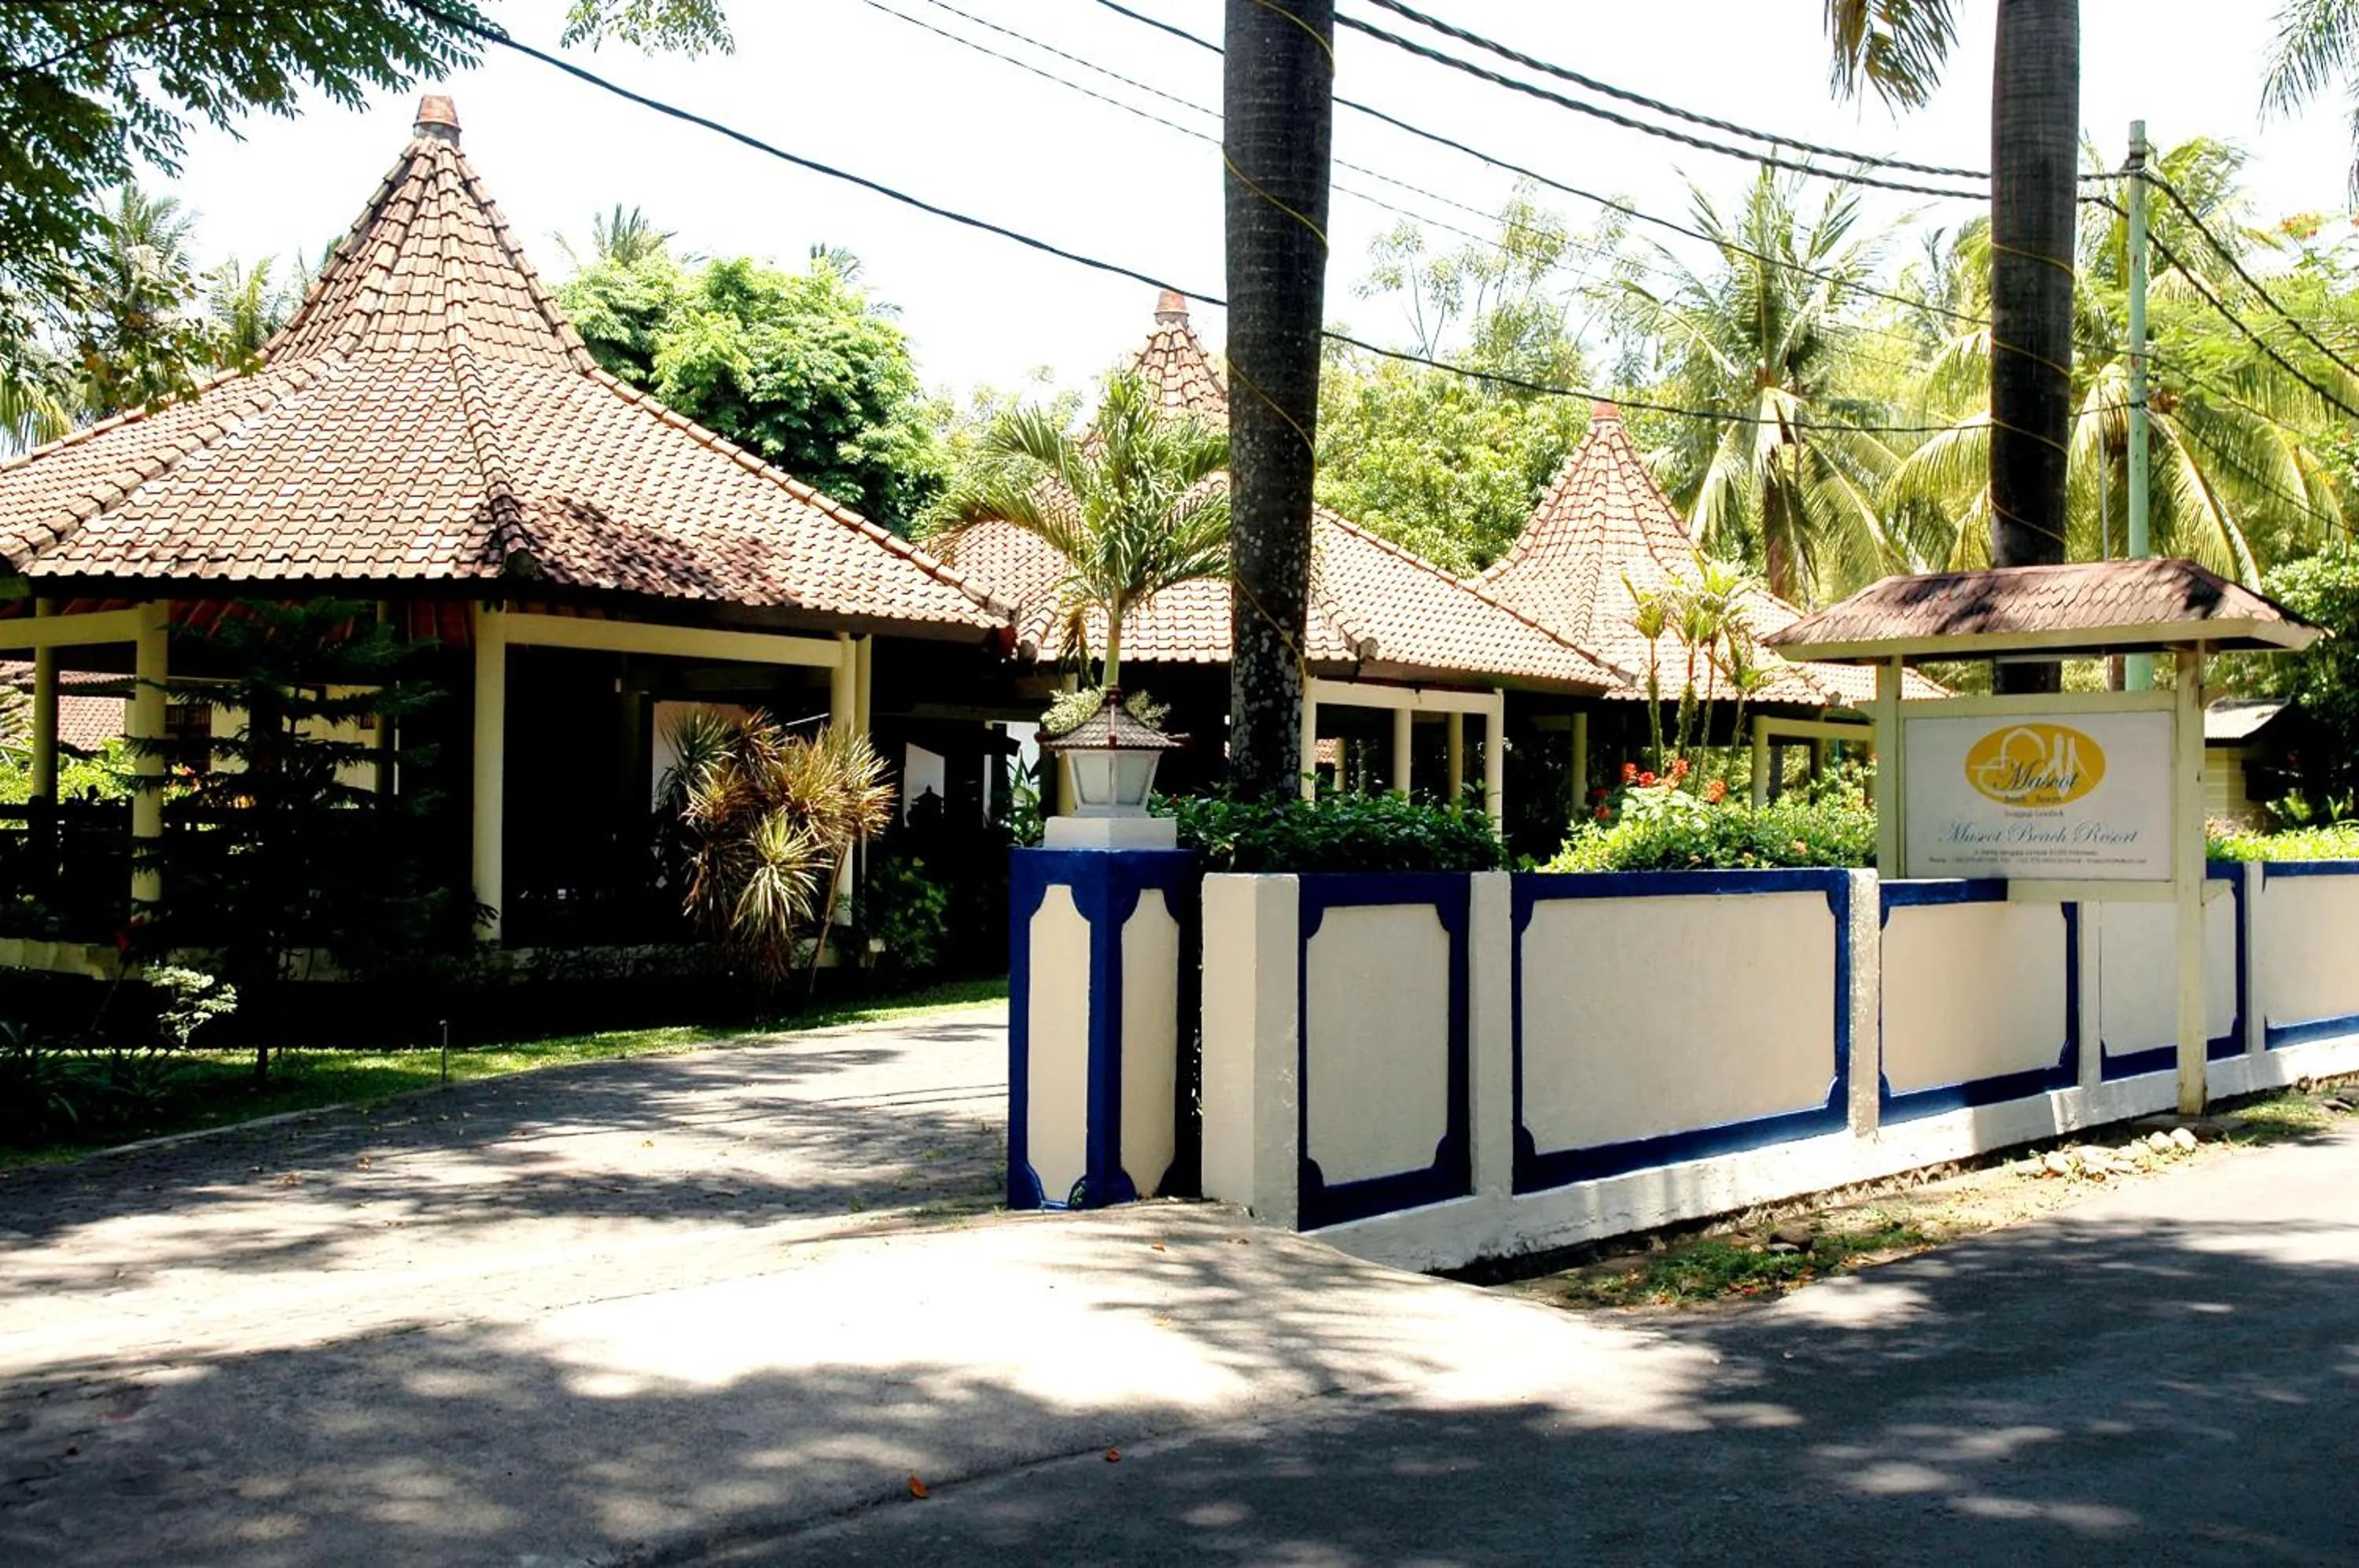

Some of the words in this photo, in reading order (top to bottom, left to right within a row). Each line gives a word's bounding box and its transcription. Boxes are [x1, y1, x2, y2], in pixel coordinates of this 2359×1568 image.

[1993, 759, 2078, 790] Mascot
[1938, 821, 2003, 844] Mascot
[2007, 821, 2067, 844] Beach
[2074, 819, 2139, 844] Resort
